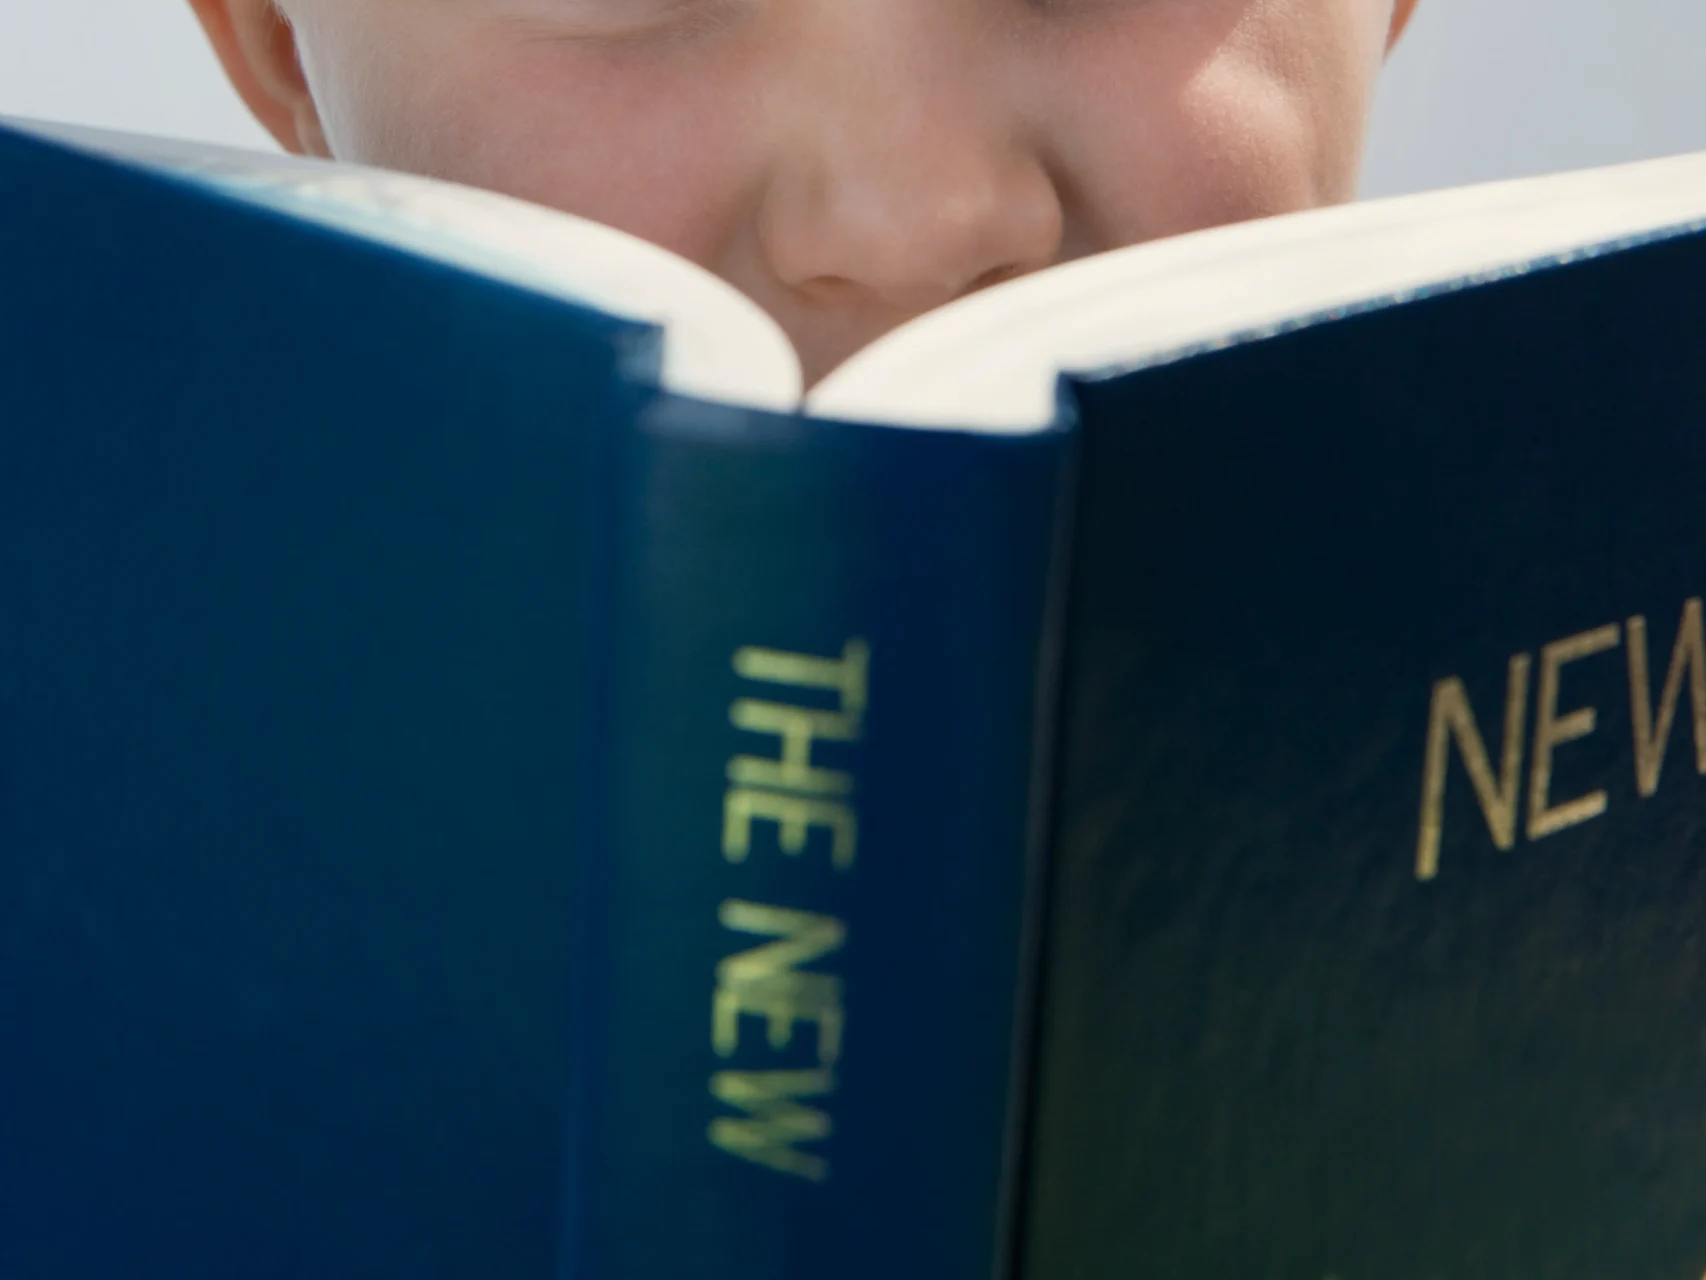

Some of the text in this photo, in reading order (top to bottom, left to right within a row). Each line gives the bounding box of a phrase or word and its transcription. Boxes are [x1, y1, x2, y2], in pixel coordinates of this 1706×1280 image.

[706, 636, 870, 1182] THE NEW
[1415, 596, 1706, 881] NEW
